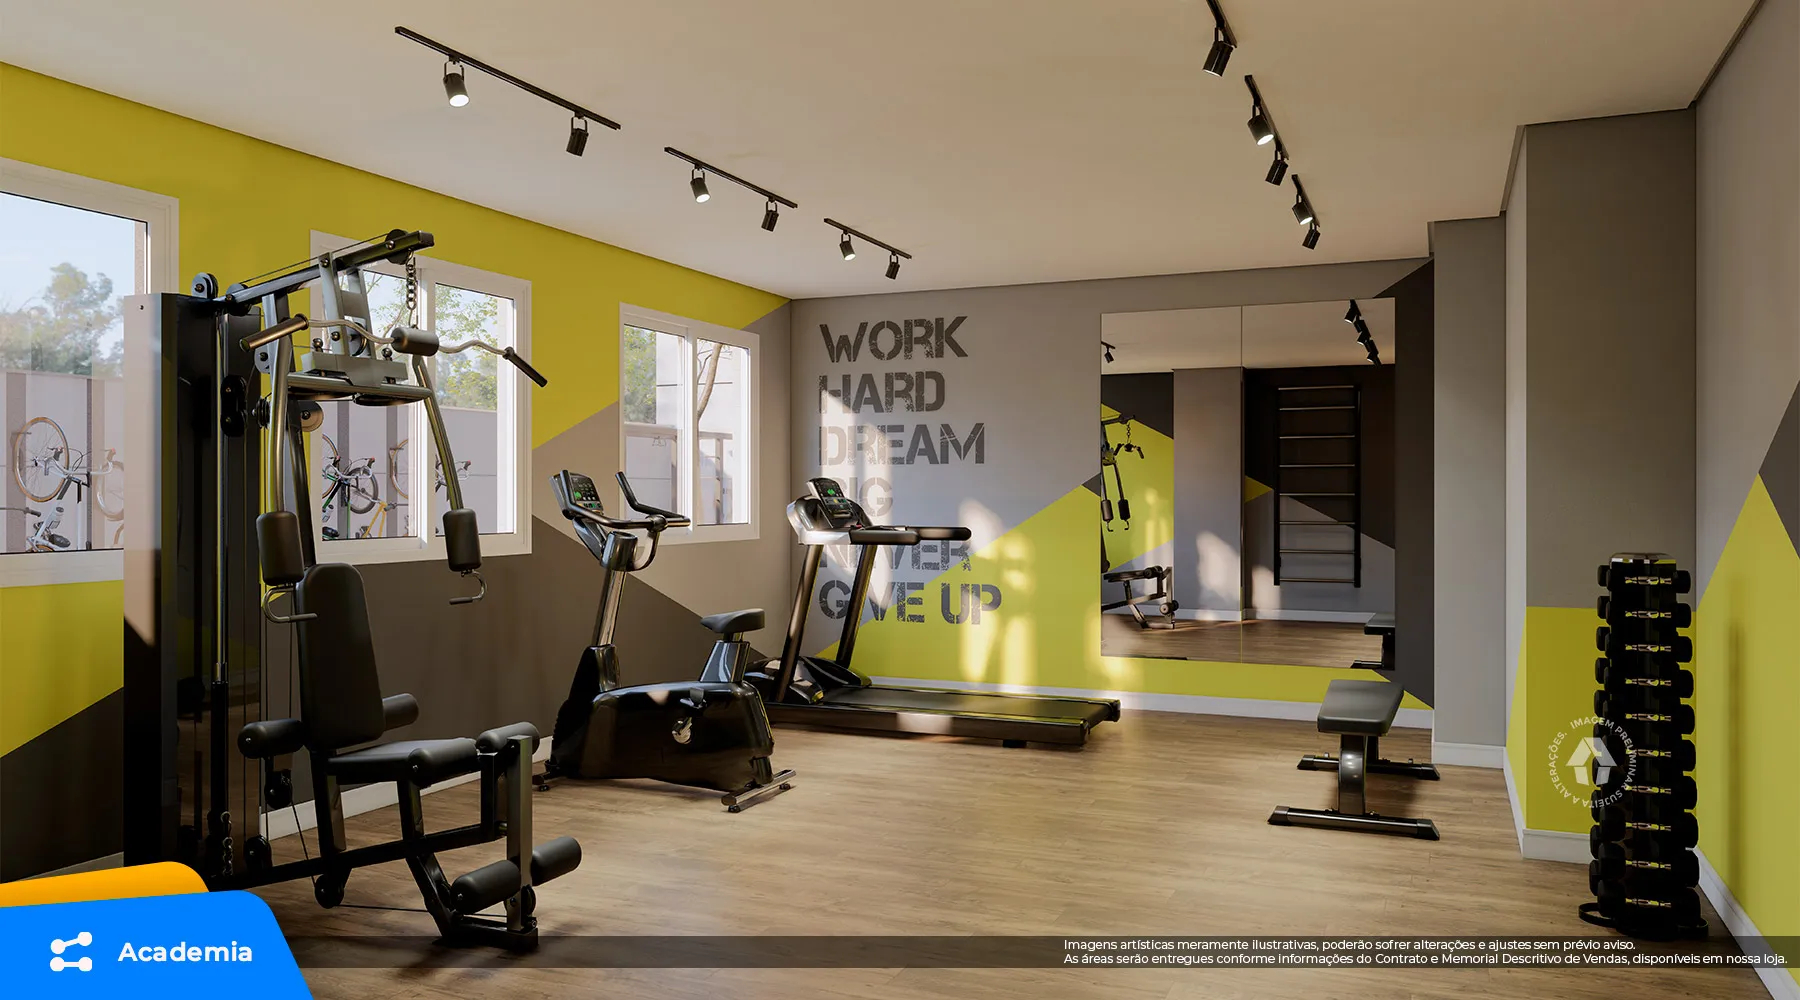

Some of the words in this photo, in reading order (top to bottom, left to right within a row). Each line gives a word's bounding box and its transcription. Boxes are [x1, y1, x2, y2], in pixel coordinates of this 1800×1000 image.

[819, 316, 968, 363] WORK
[818, 370, 945, 414] HARD
[818, 423, 985, 465] DREAM
[831, 477, 893, 517] IG
[819, 580, 925, 623] GVE
[941, 583, 1002, 625] UP
